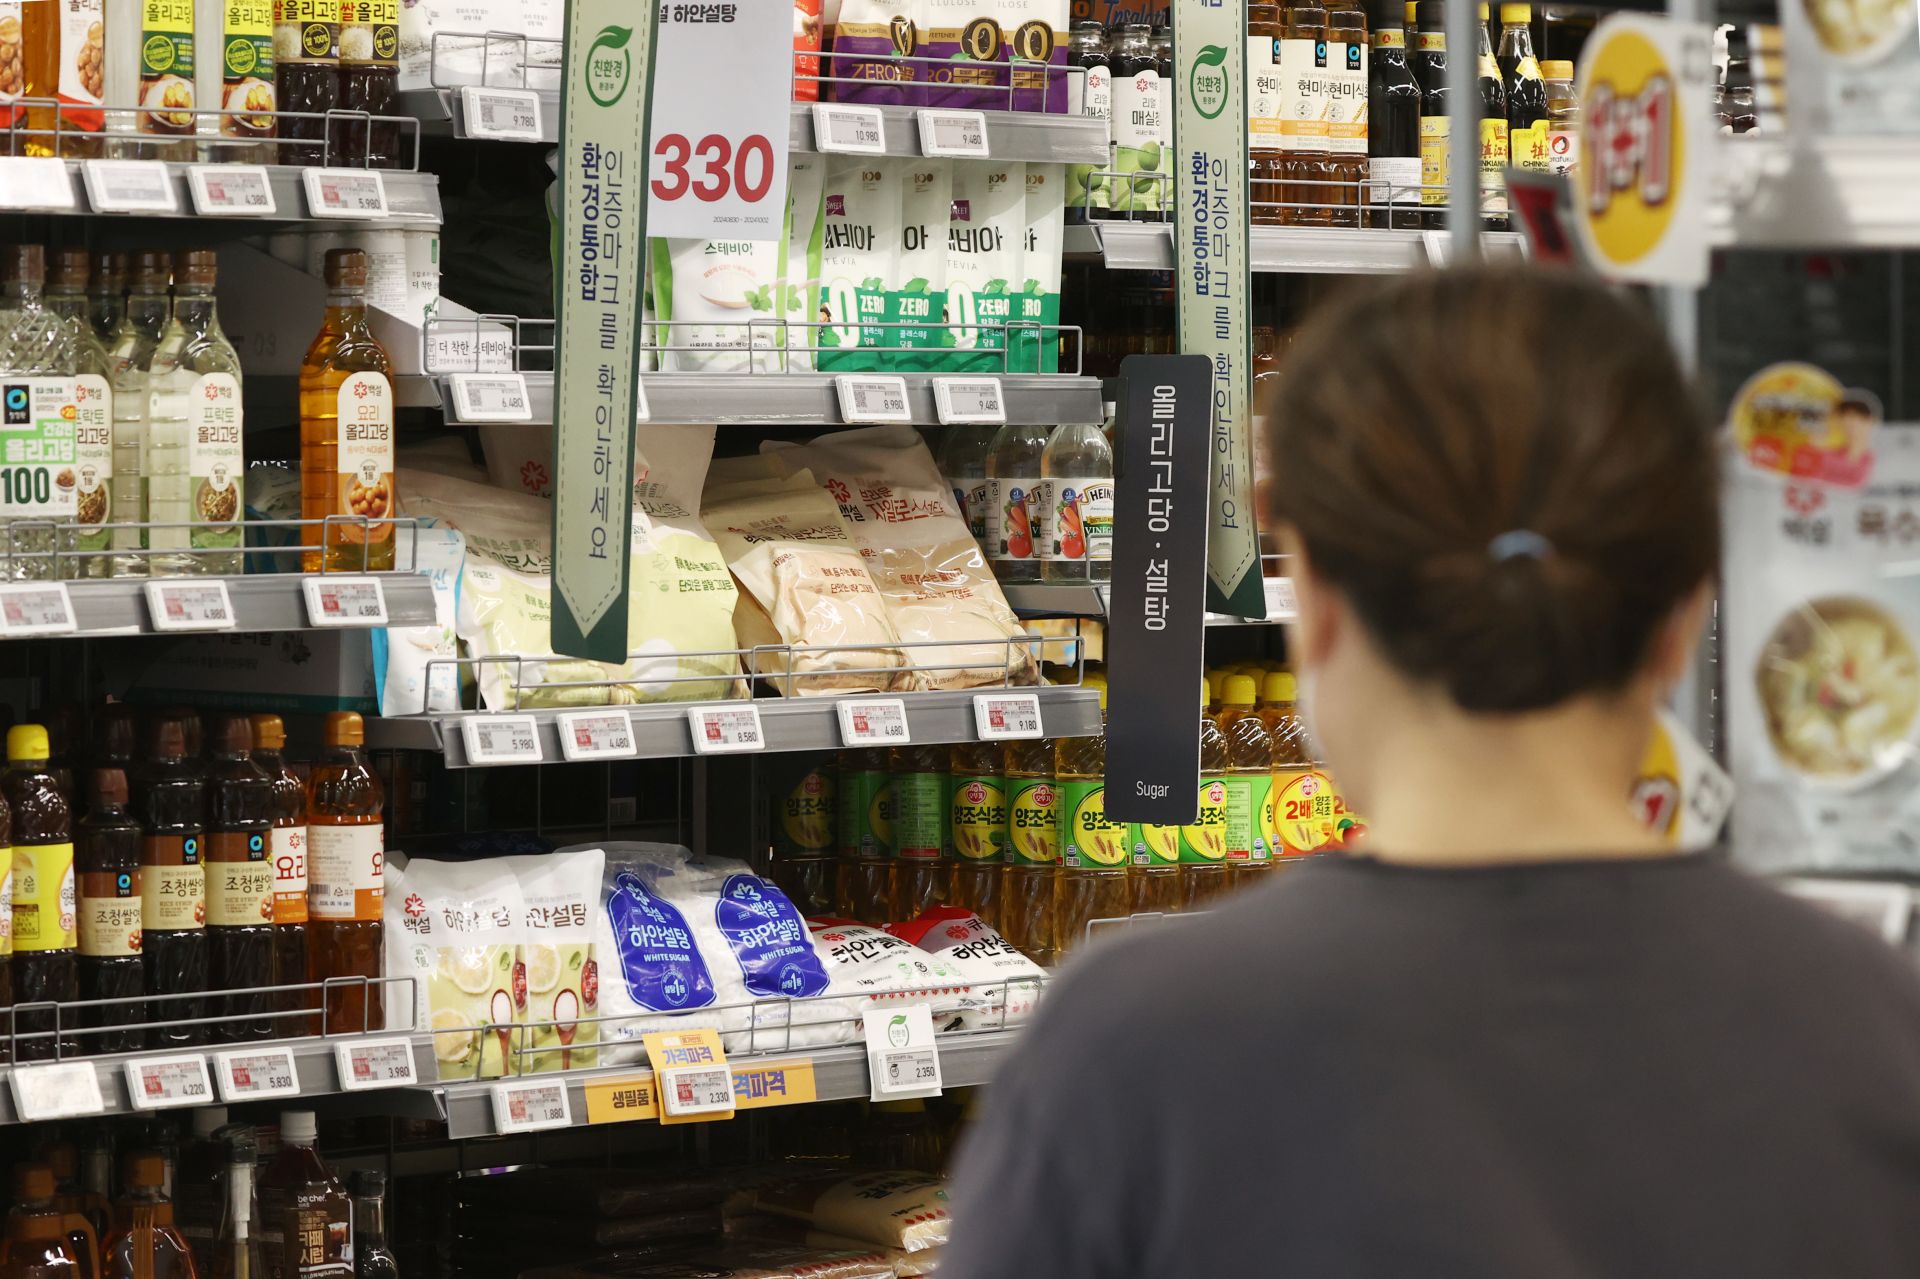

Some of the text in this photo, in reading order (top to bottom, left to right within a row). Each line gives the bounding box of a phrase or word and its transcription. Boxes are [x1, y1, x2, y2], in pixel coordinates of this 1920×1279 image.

[341, 2, 398, 21] 쌀올리고
[674, 4, 737, 23] 하얀설탕
[593, 60, 623, 79] 친환경
[1196, 75, 1222, 94] 친환경
[1256, 77, 1281, 95] 현미
[651, 133, 774, 203] 330
[580, 142, 602, 301] 환경통합
[1191, 151, 1209, 296] 환경통합
[705, 242, 753, 255] 스테비아
[860, 295, 885, 315] ZERO
[899, 297, 930, 317] ZERO
[978, 298, 1010, 317] ZERO
[439, 341, 448, 356] 더
[451, 341, 470, 356] 착한
[368, 384, 382, 397] 백설
[357, 405, 380, 421] 요리
[197, 426, 239, 444] 올리고당
[346, 424, 389, 441] 올리고당
[1215, 352, 1239, 530] 확인하세요
[589, 364, 616, 559] 확인하세요
[1, 467, 50, 504] 100
[1135, 781, 1170, 798] Sugar
[786, 799, 837, 818] 양조식
[1286, 800, 1311, 819] 2배
[371, 852, 383, 876] 요
[750, 899, 780, 918] 백설
[404, 917, 431, 934] 백설
[738, 919, 801, 949] 하얀설탕
[628, 924, 691, 950] 하얀설탕
[644, 954, 691, 962] WHITE SUGAR
[760, 945, 805, 960] WHITE SUGAR
[662, 1046, 714, 1065] 가격파격
[732, 1070, 787, 1100] 격파격
[612, 1088, 649, 1108] 생필품
[300, 1246, 324, 1265] 시럽
